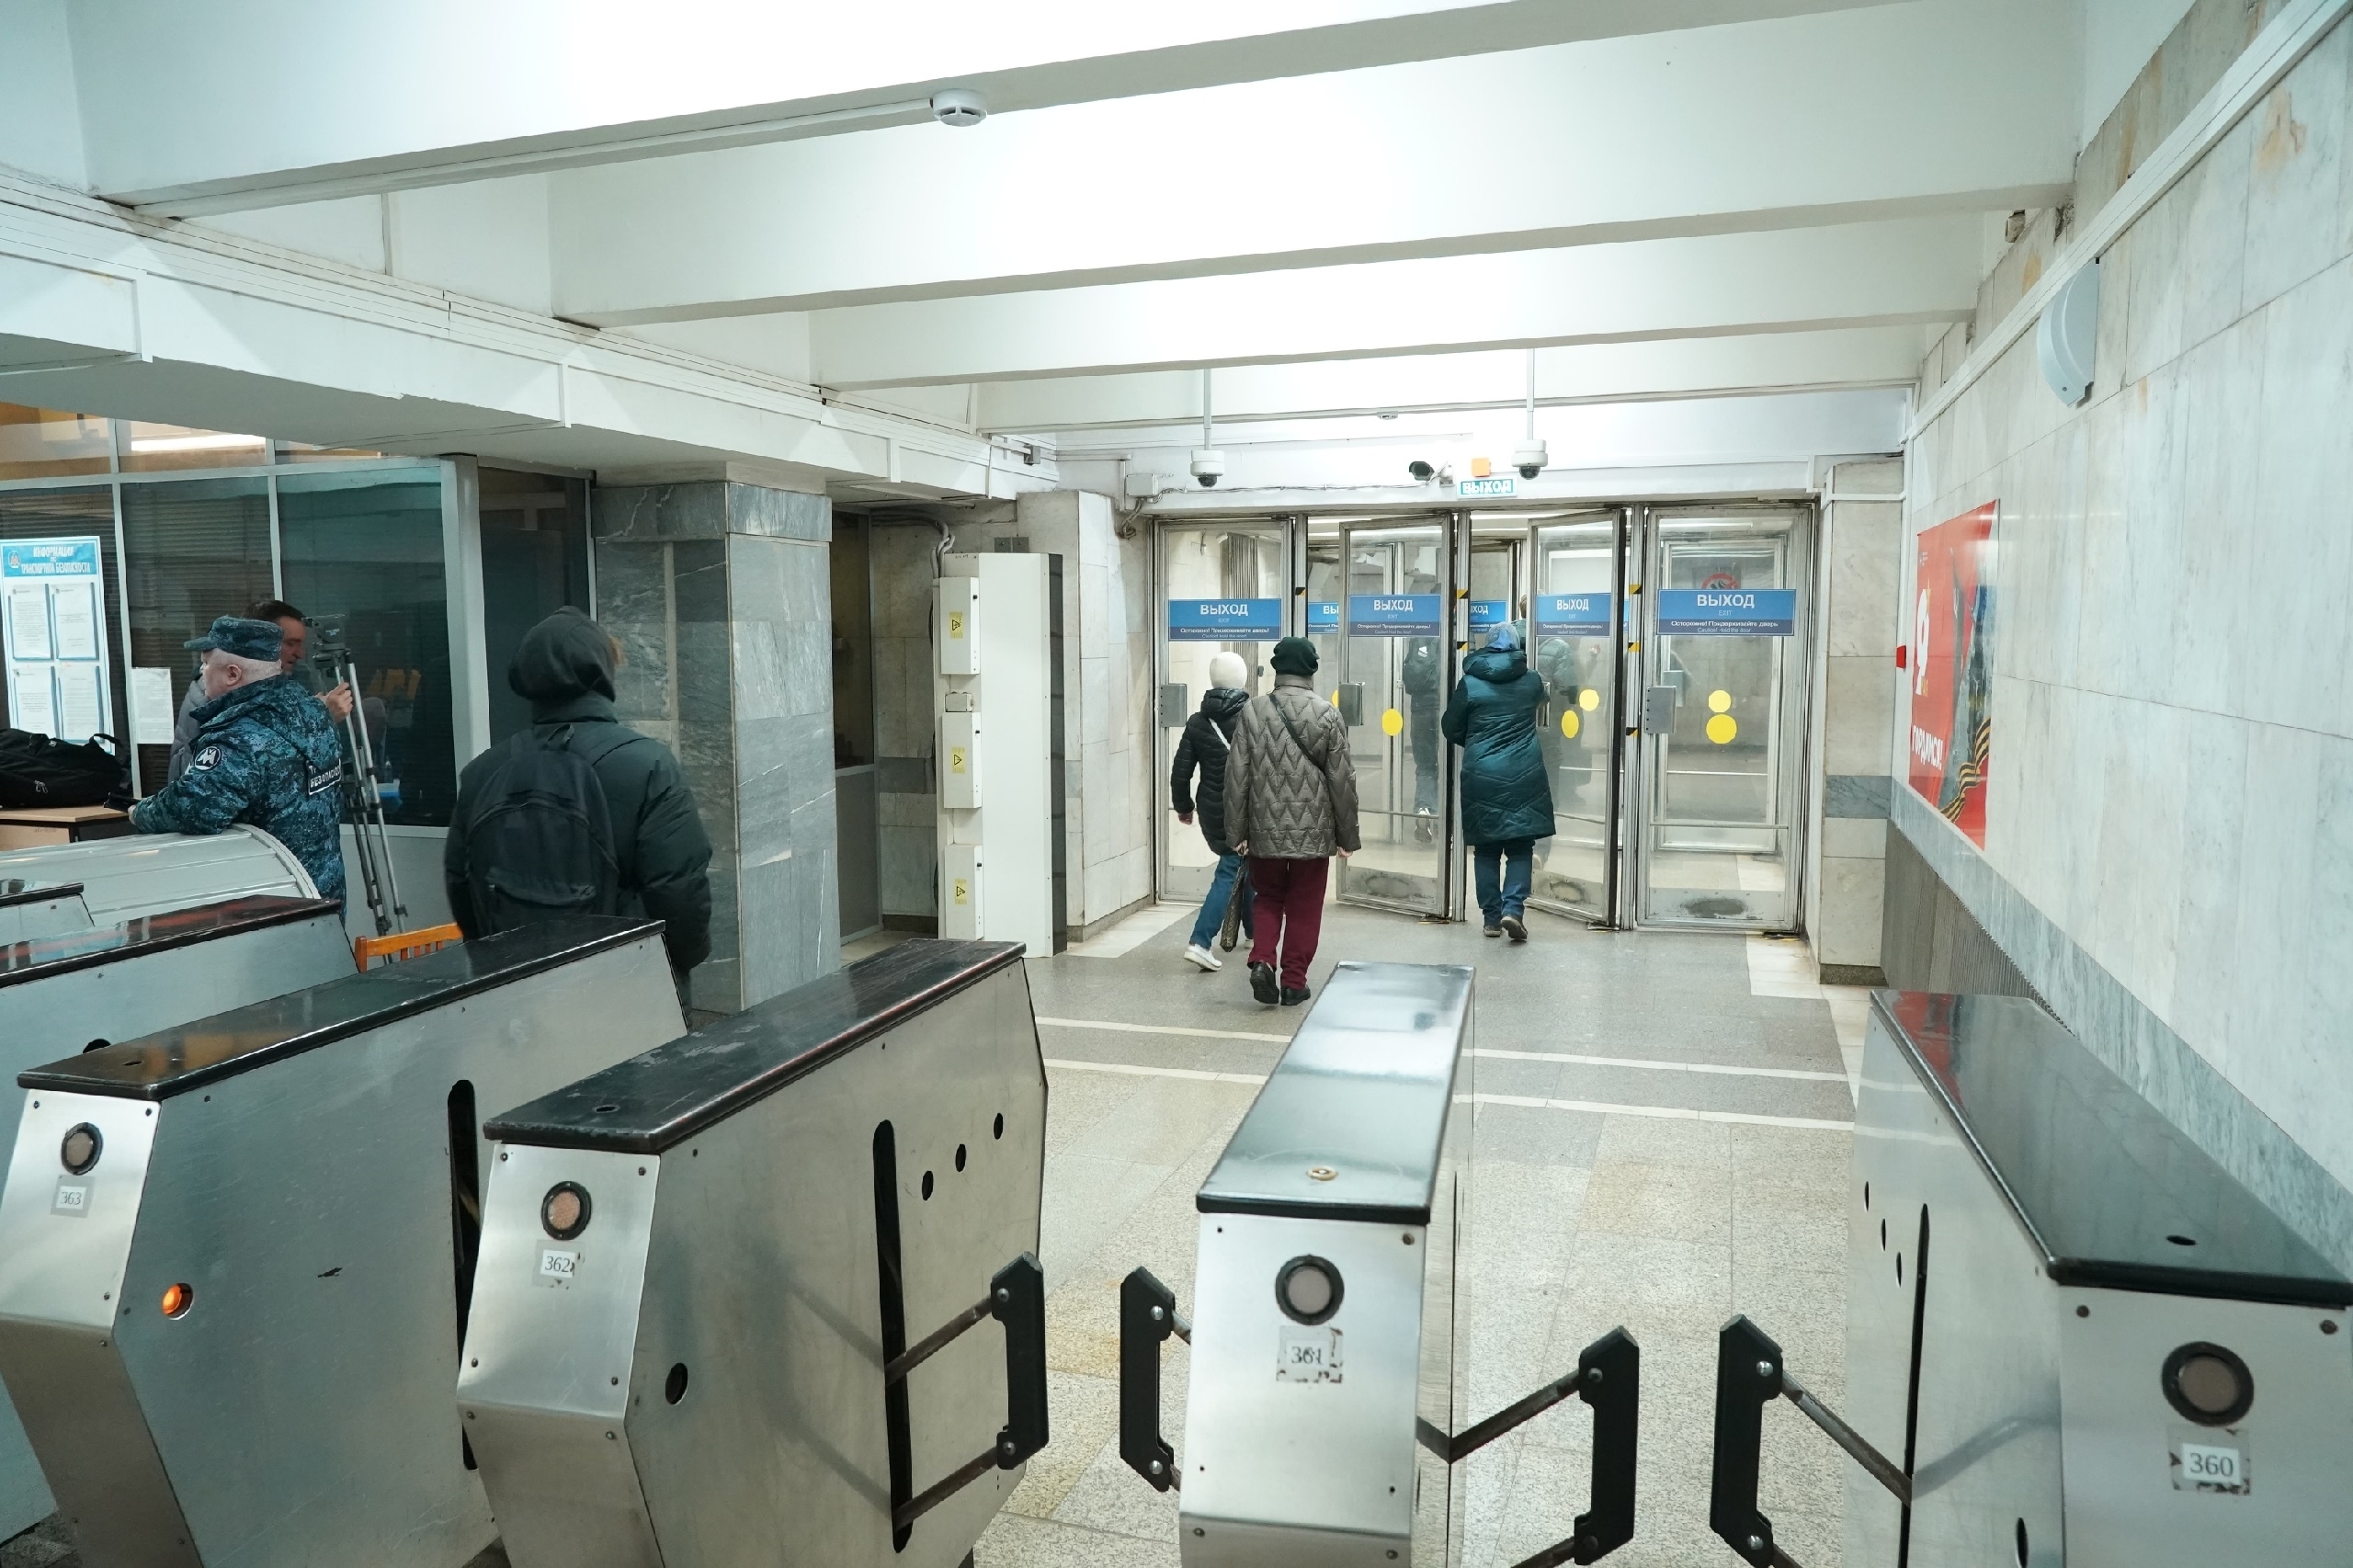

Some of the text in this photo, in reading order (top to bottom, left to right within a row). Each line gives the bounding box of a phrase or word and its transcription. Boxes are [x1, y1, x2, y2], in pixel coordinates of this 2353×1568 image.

[1461, 480, 1512, 494] ВЫХОД
[1373, 599, 1414, 612] ВЫХОД
[1556, 598, 1590, 611] ВЫХОД
[1697, 594, 1756, 608] ВЫХОД
[1199, 604, 1249, 617] ВЫХОД
[60, 1191, 83, 1206] 363
[544, 1256, 571, 1273] 362
[1290, 1346, 1323, 1365] 361
[2189, 1452, 2234, 1477] 360
